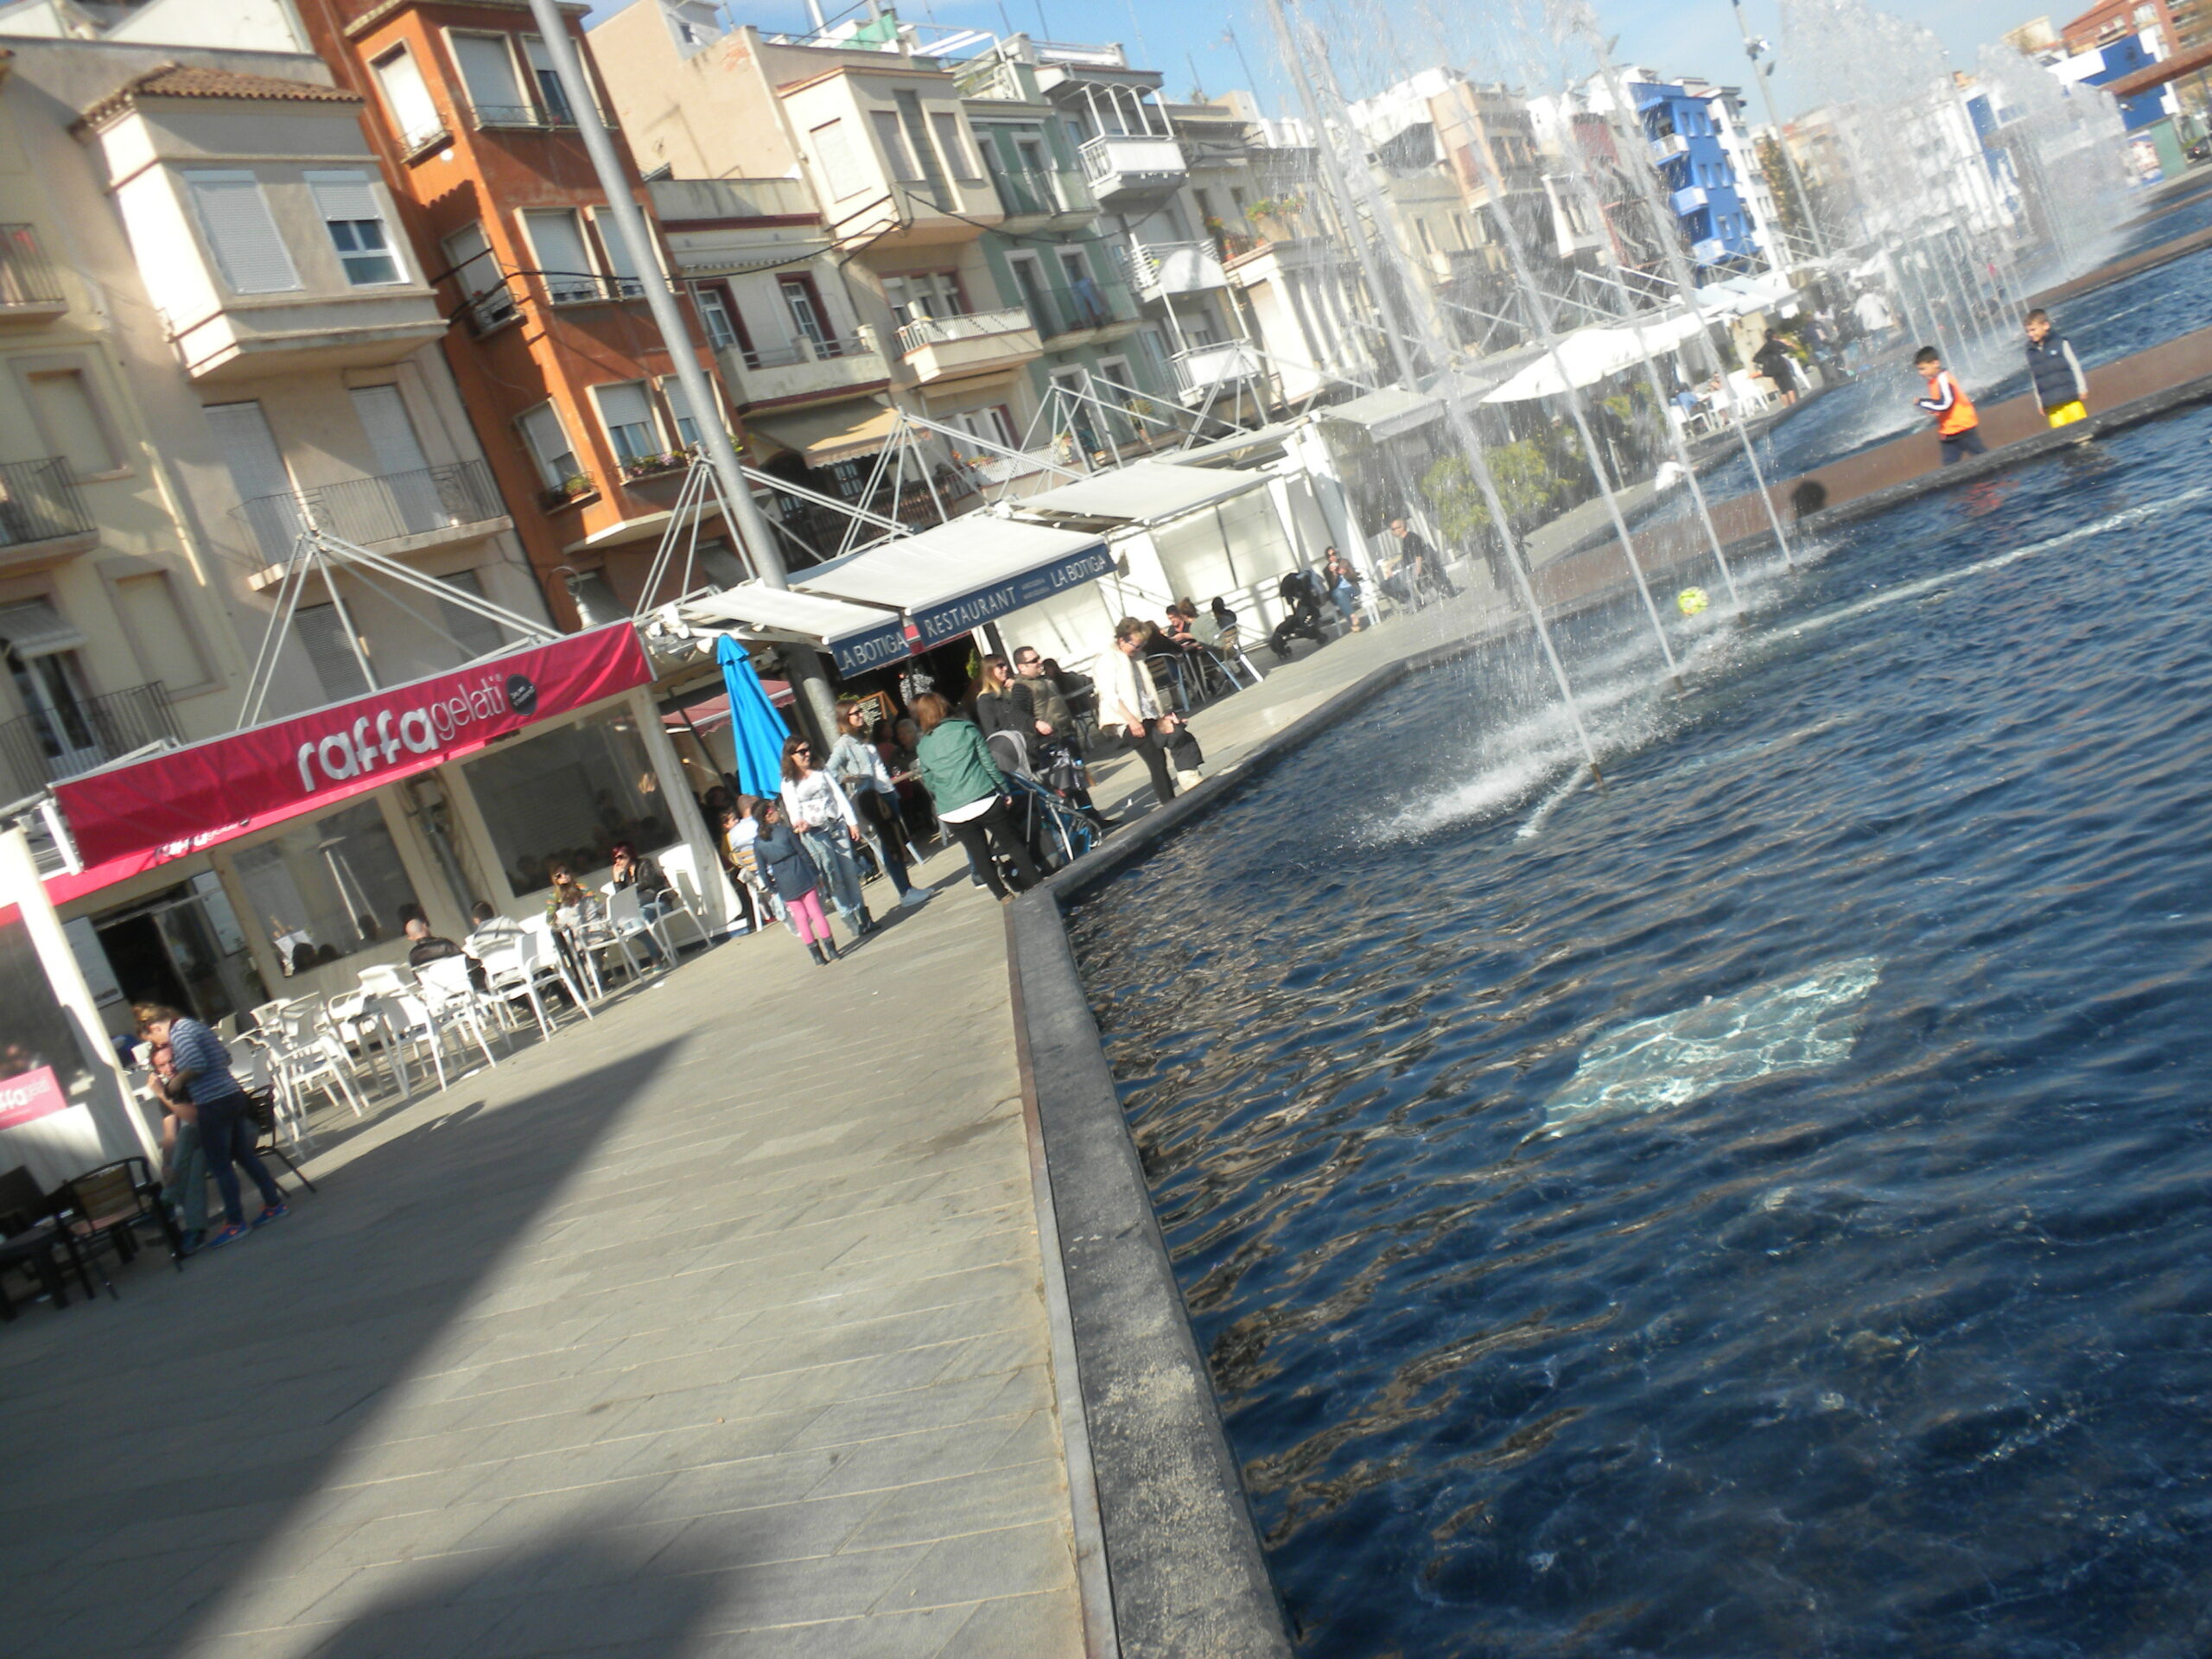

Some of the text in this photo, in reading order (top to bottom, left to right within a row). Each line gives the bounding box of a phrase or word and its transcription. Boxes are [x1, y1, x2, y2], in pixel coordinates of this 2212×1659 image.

[1050, 569, 1068, 588] LA
[1065, 554, 1106, 580] BOTIGA
[924, 586, 1016, 638] RESTAURANT
[853, 632, 909, 664] BOTIGA
